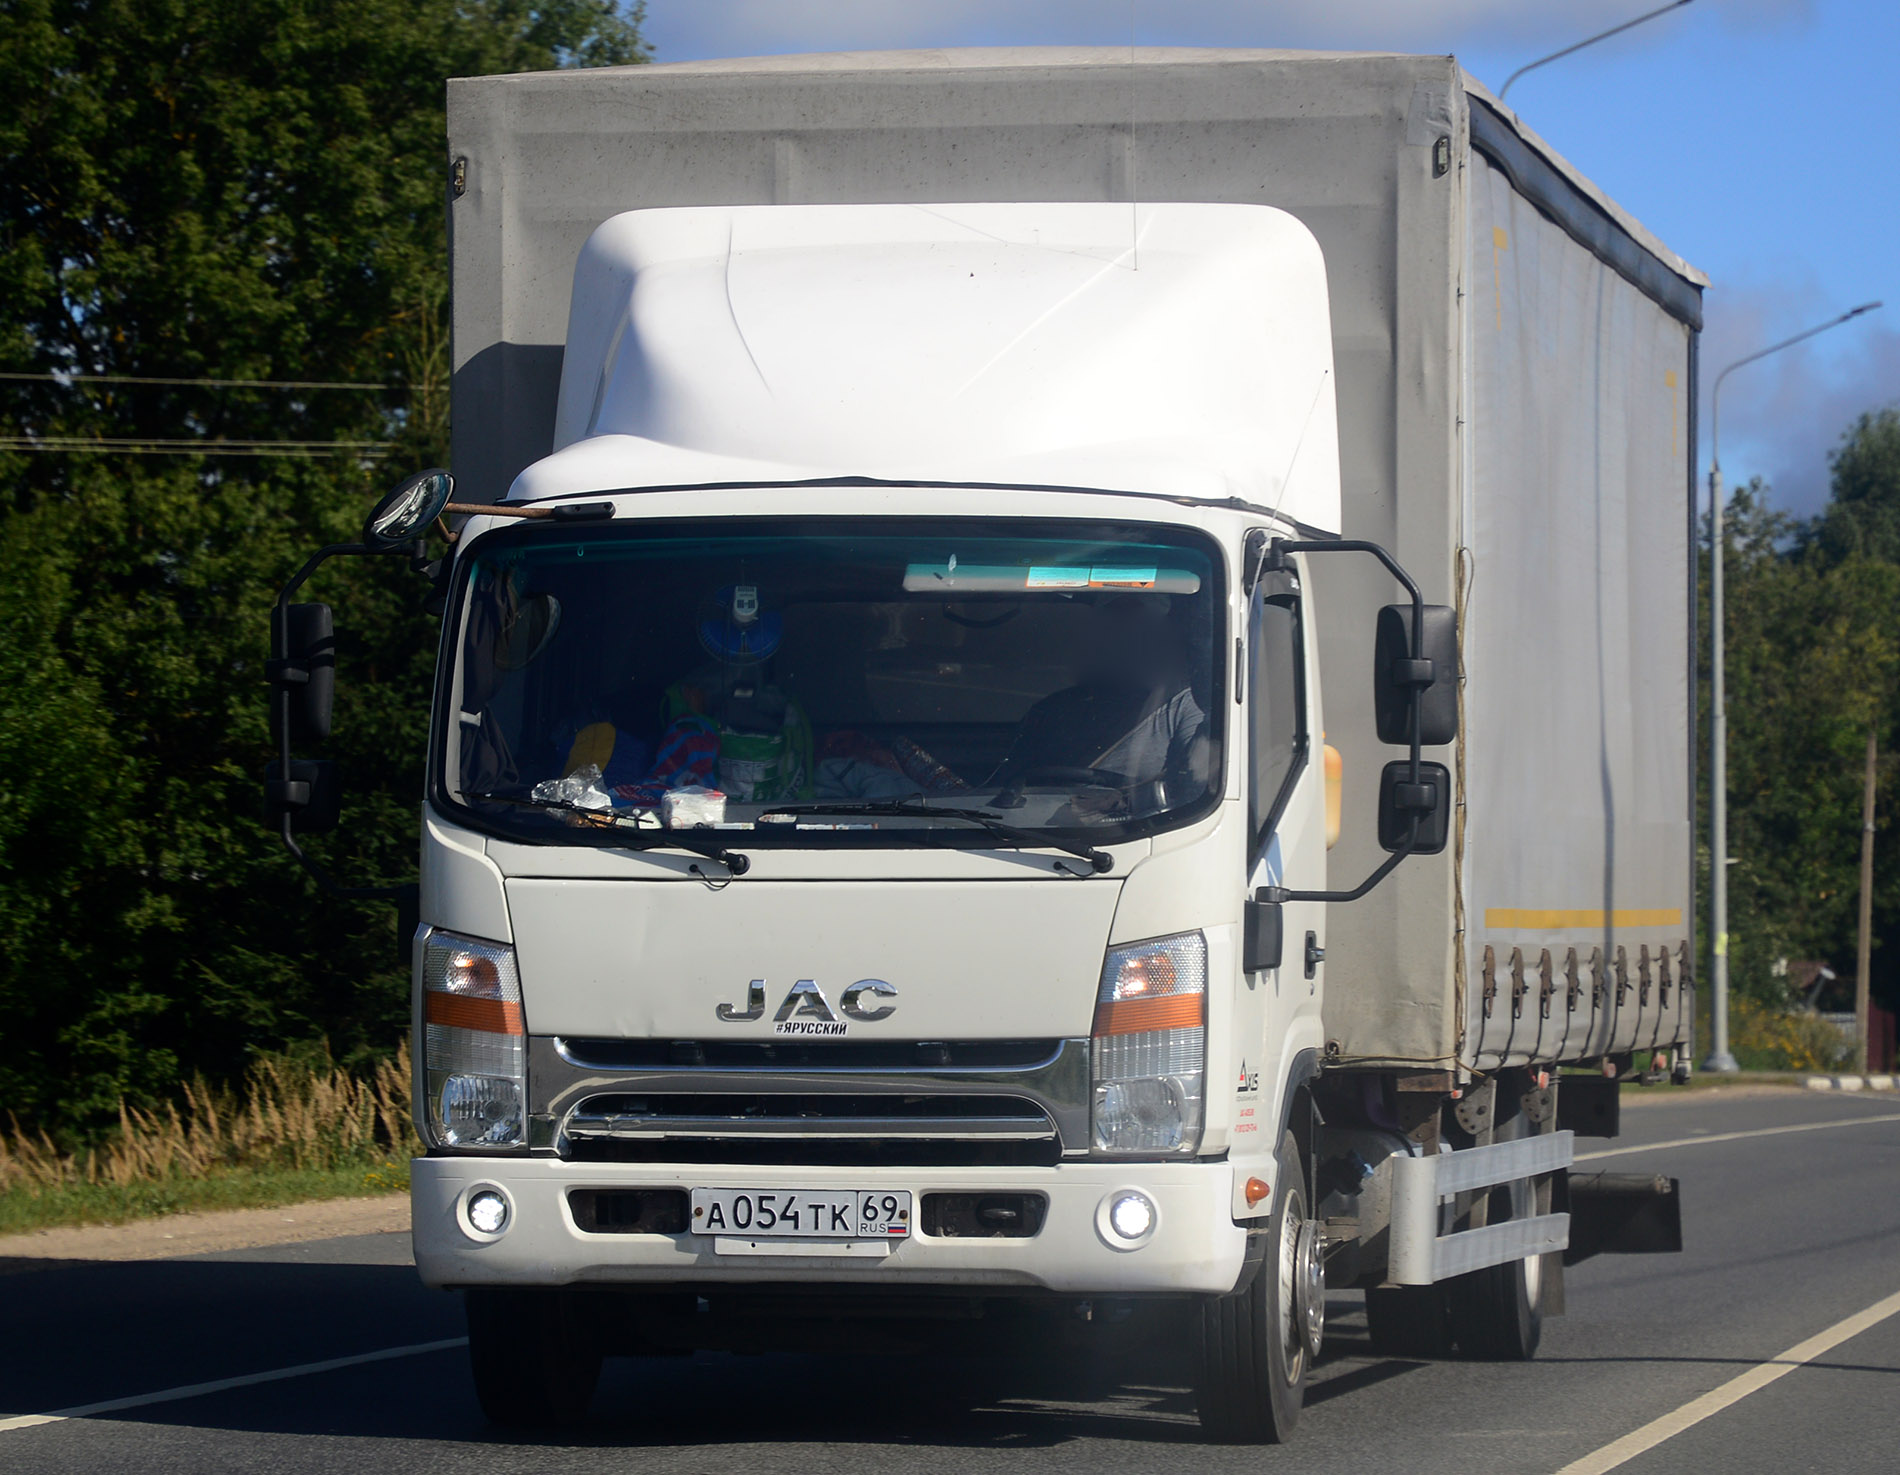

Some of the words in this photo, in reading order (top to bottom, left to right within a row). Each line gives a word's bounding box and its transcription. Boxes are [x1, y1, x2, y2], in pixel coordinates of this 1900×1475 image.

[716, 978, 899, 1023] JAC
[775, 1021, 848, 1036] #ЯРУССКИЙ
[862, 1194, 898, 1222] 69
[860, 1223, 886, 1233] RUS
